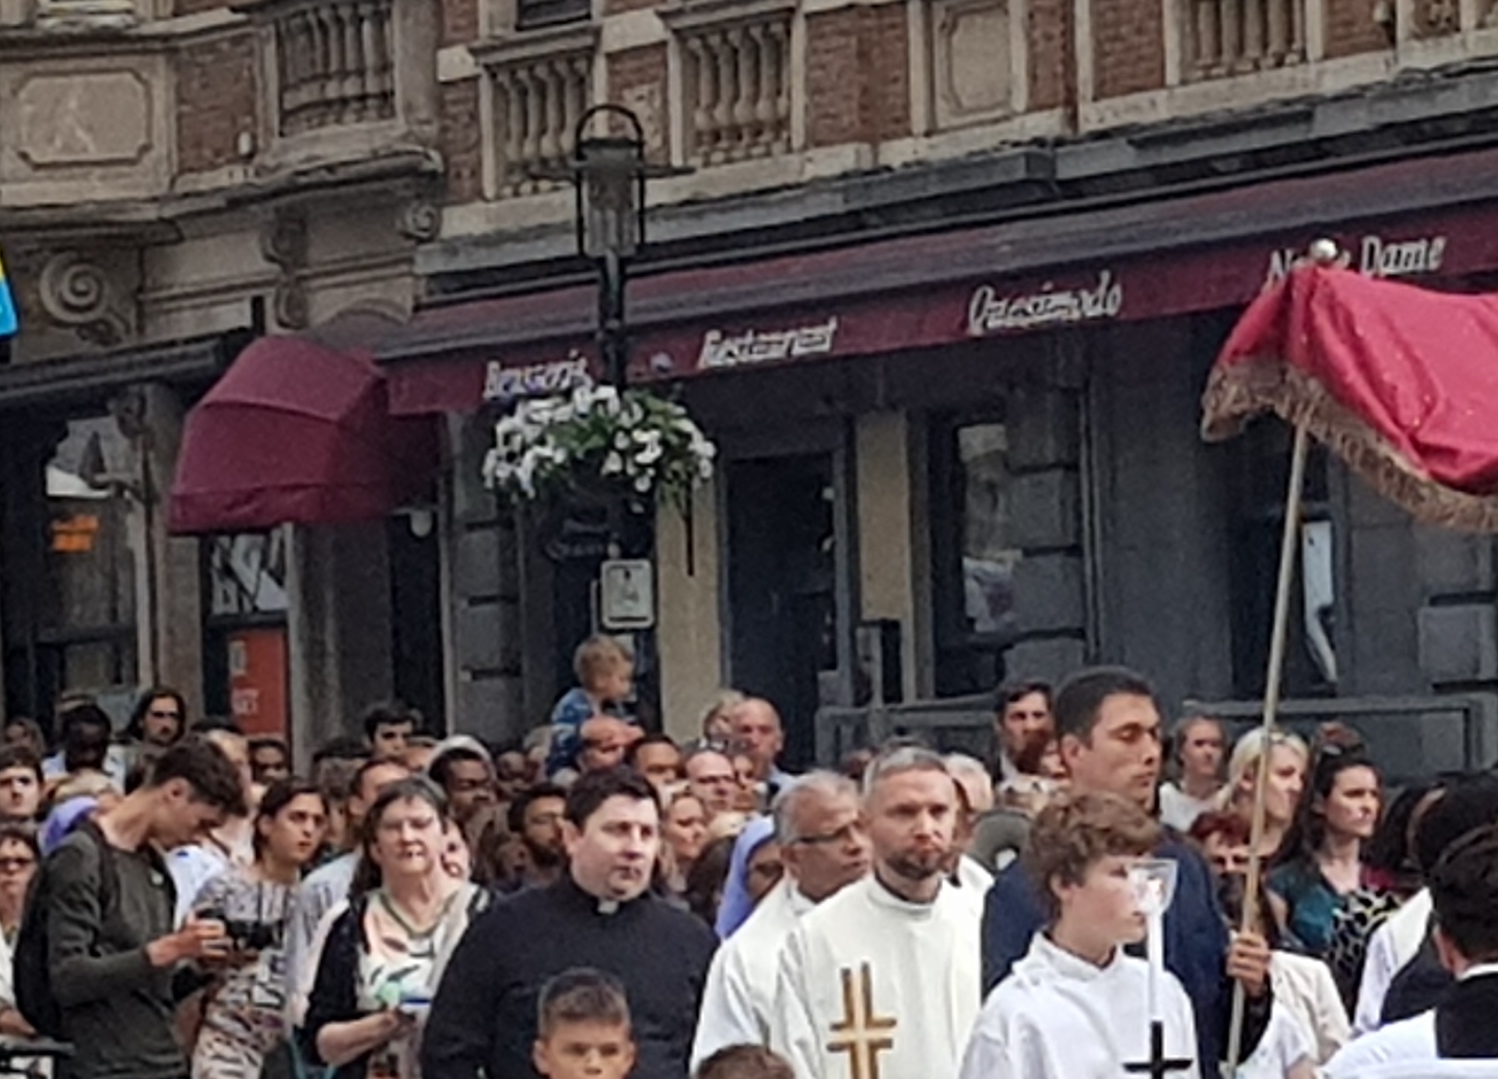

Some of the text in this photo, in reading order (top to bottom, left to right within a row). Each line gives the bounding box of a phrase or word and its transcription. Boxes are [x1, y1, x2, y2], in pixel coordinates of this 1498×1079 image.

[697, 315, 838, 369] Restaurant
[968, 269, 1122, 336] Quasimodo
[1361, 235, 1447, 279] Dame
